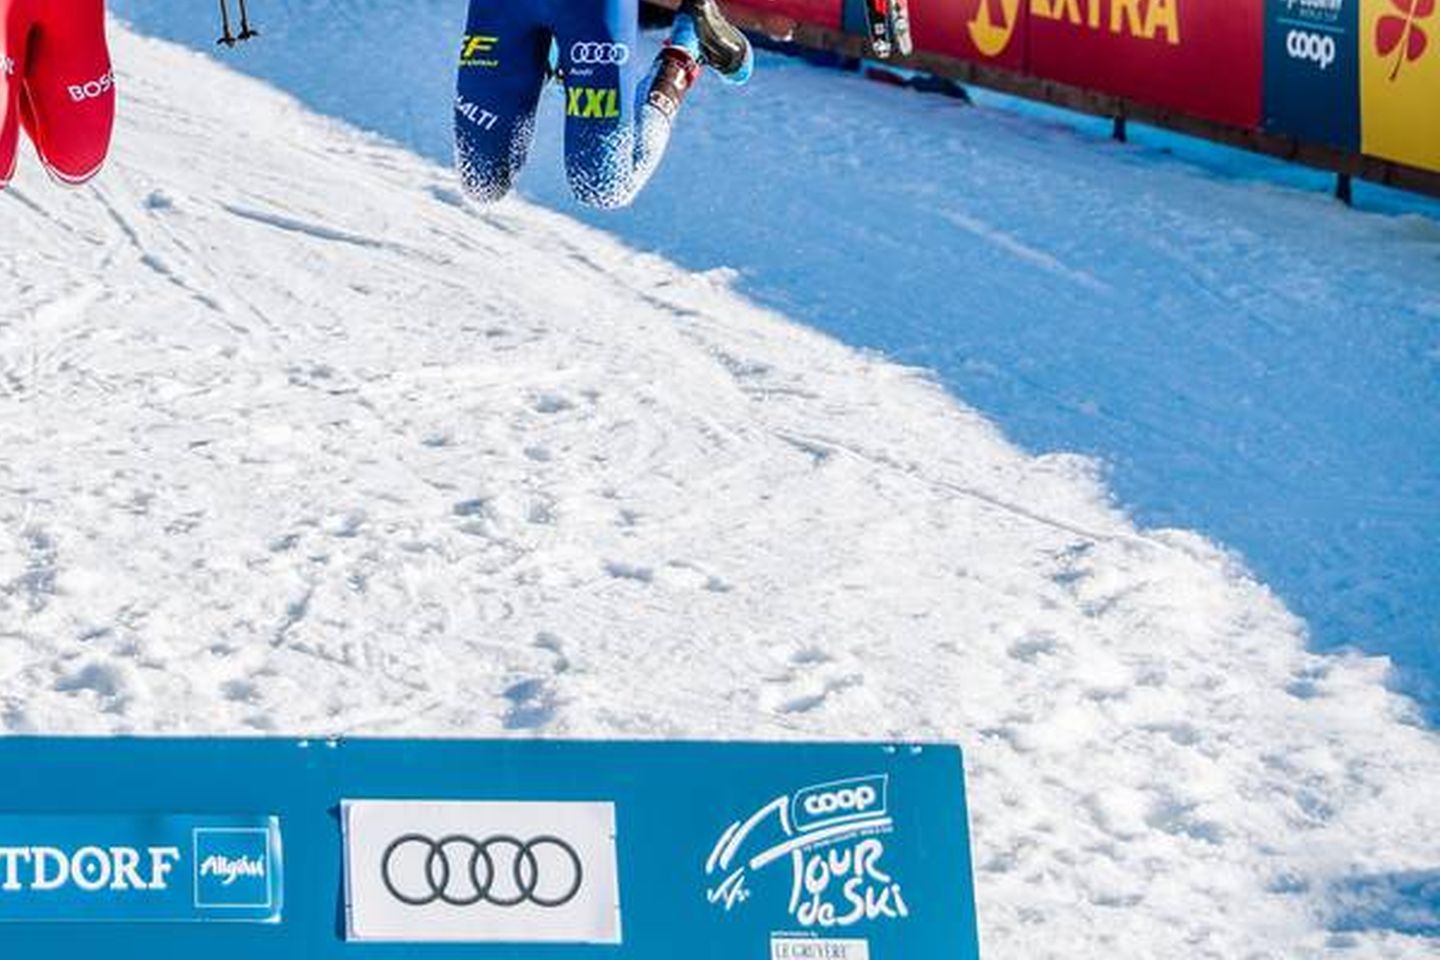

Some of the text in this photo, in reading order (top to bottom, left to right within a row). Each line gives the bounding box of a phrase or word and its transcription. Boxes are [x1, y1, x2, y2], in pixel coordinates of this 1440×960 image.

[1286, 29, 1335, 69] coop
[567, 87, 620, 118] XXL
[804, 785, 876, 814] coop
